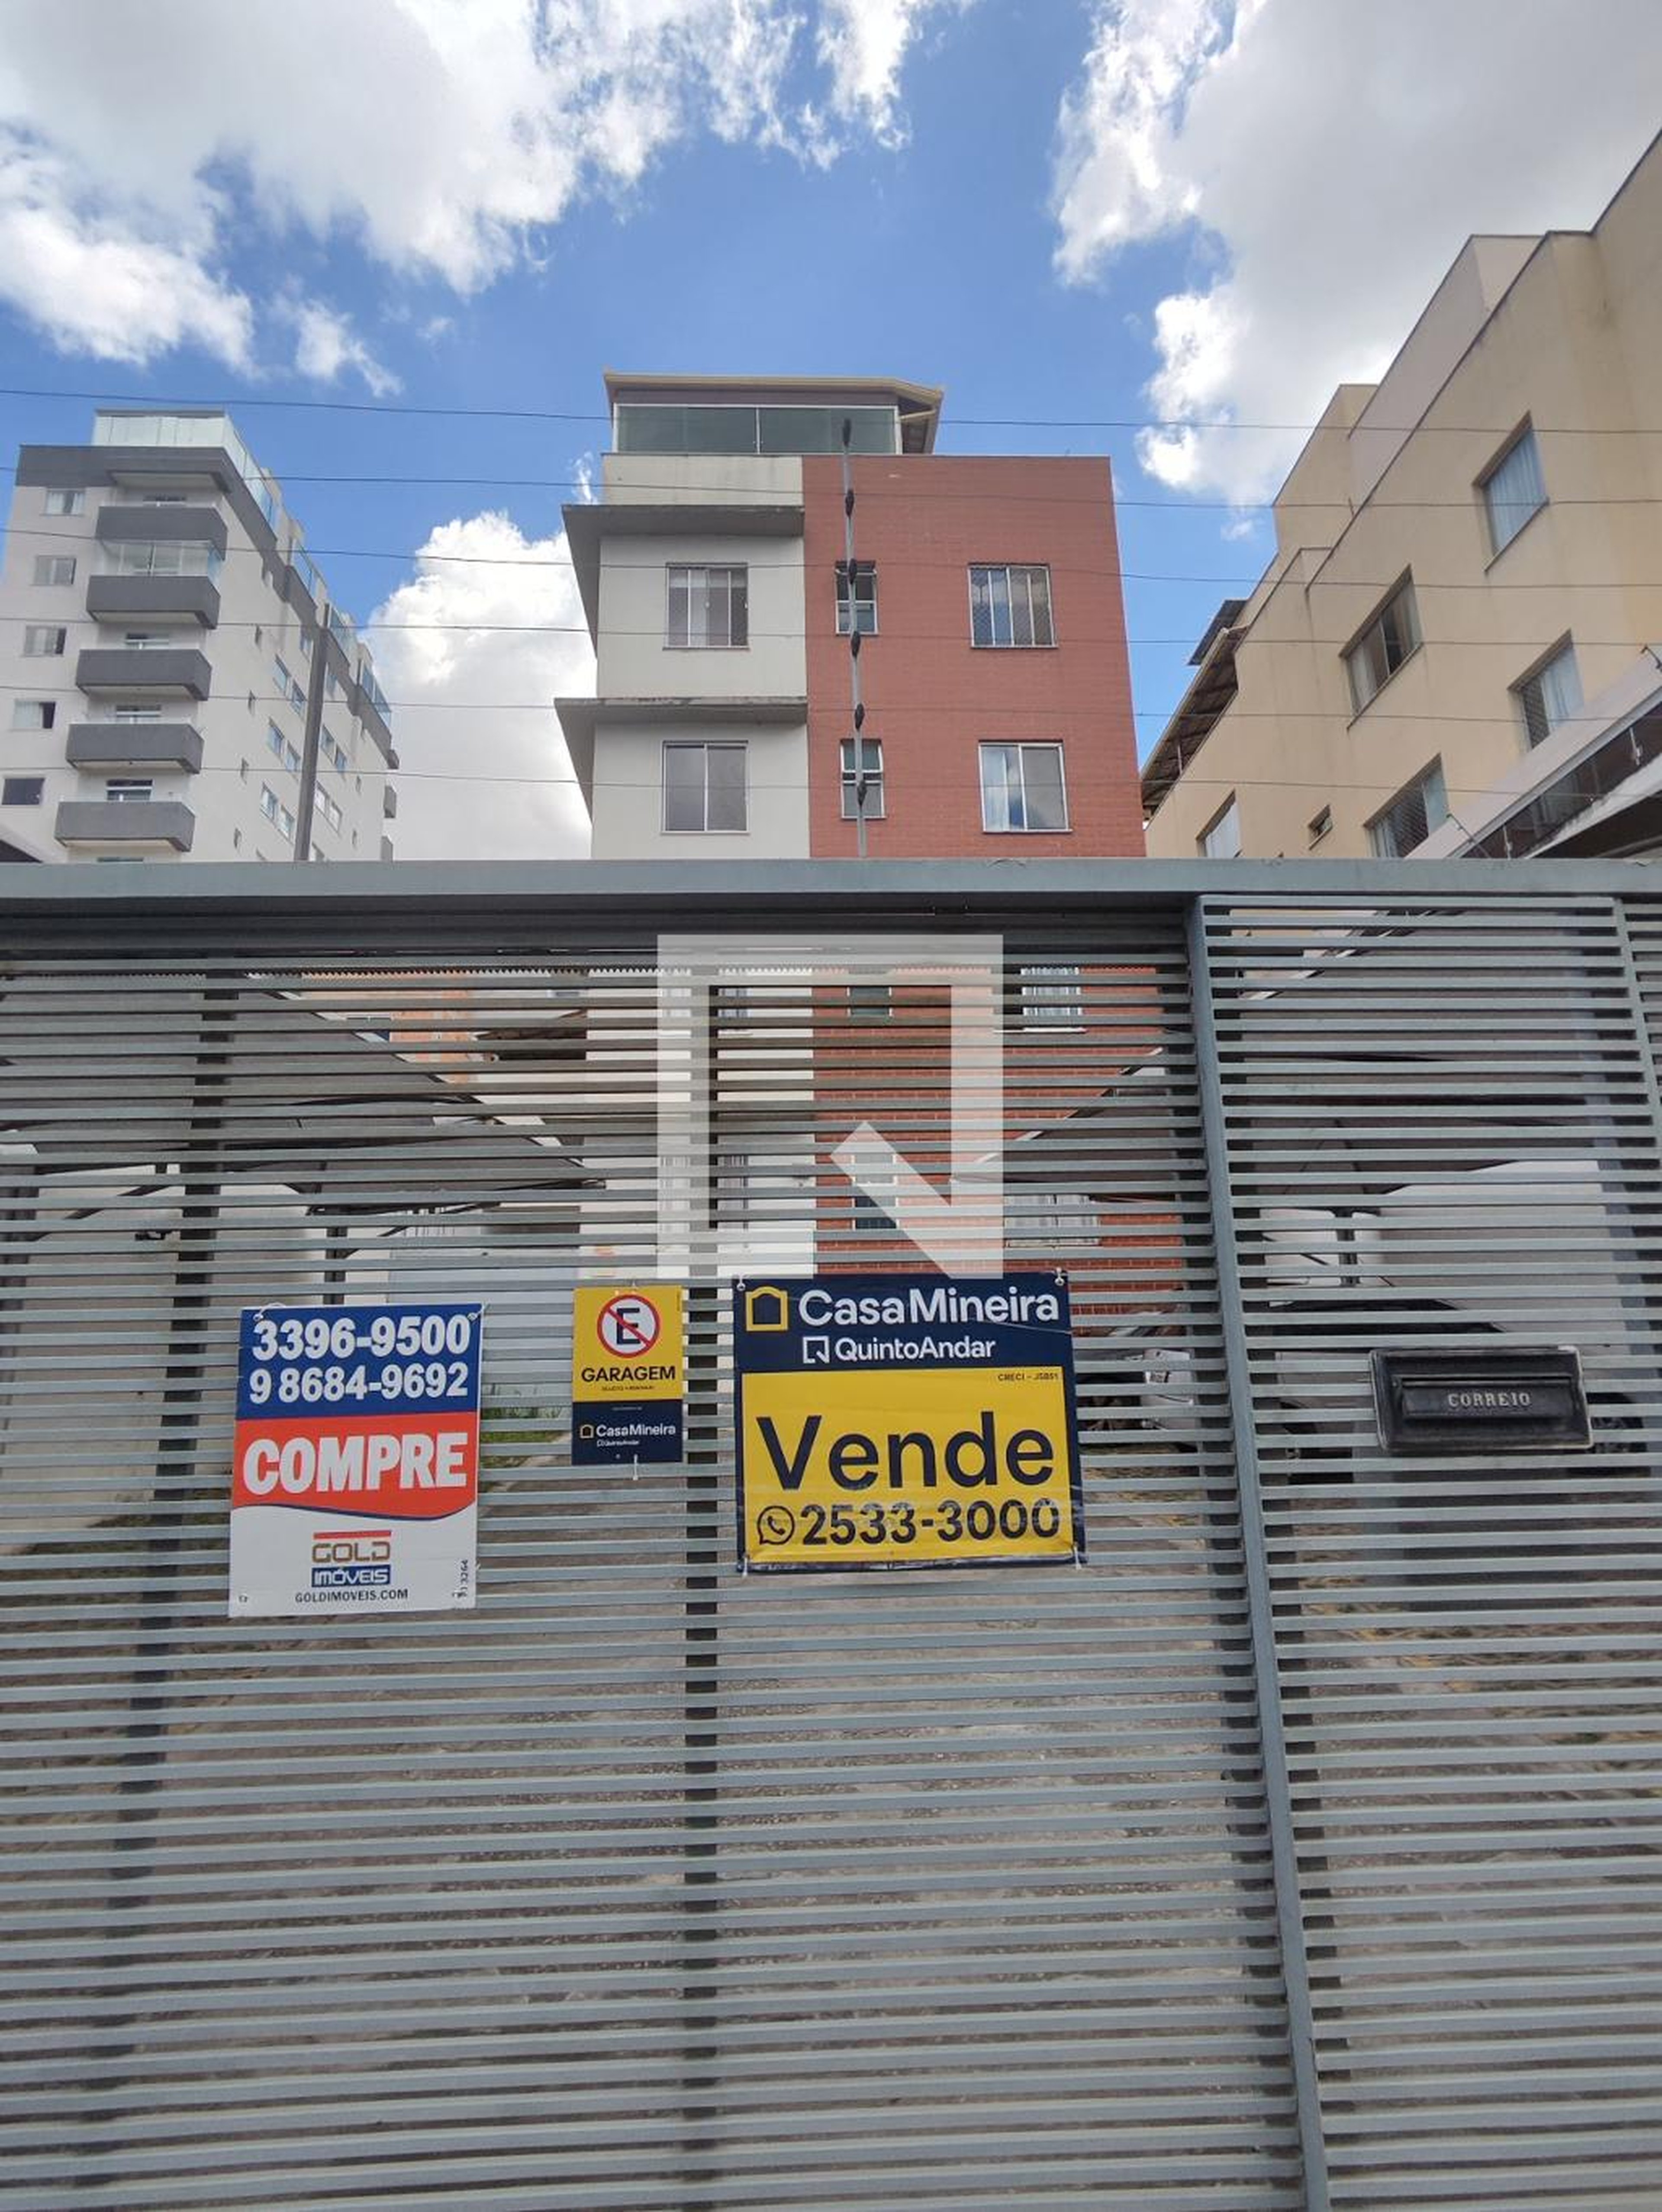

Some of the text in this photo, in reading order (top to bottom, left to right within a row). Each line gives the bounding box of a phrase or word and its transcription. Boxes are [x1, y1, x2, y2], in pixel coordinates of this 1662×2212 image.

[798, 1286, 1060, 1326] CasaMineira
[252, 1314, 471, 1361] 3396-9500
[834, 1335, 996, 1361] QuintoAndar
[279, 1362, 468, 1403] 8684-9692
[581, 1366, 676, 1382] GARAGEM
[1448, 1392, 1531, 1407] CORREIO
[243, 1432, 468, 1495] COMPRE
[756, 1412, 1054, 1491] Vende
[801, 1497, 1060, 1546] 2533-3000
[312, 1542, 390, 1563] GOLD
[295, 1589, 408, 1603] GOLDIMOVEIS.COM
